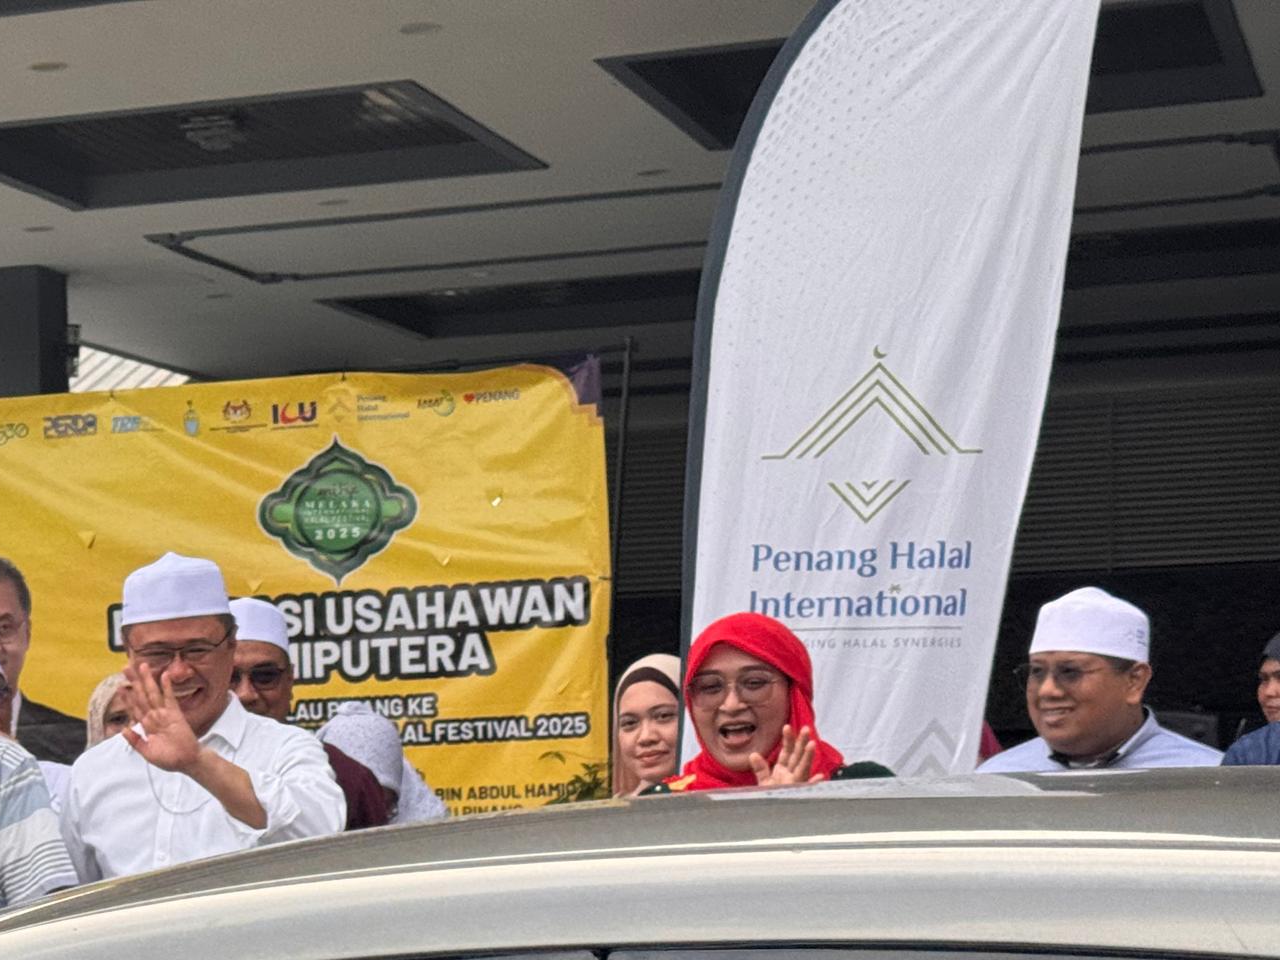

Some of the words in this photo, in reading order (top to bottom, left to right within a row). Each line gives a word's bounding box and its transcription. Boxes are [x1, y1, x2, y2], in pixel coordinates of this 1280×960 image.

[271, 401, 317, 425] ICU
[315, 527, 361, 540] 2025
[752, 543, 878, 578] Penang
[889, 540, 972, 570] Halal
[325, 582, 586, 634] USAHAWAN
[750, 587, 968, 618] International
[843, 637, 888, 649] HALAL
[407, 696, 436, 716] KE
[435, 719, 532, 741] FESTIVAL
[537, 715, 587, 737] 2025
[467, 784, 522, 800] ABDUL
